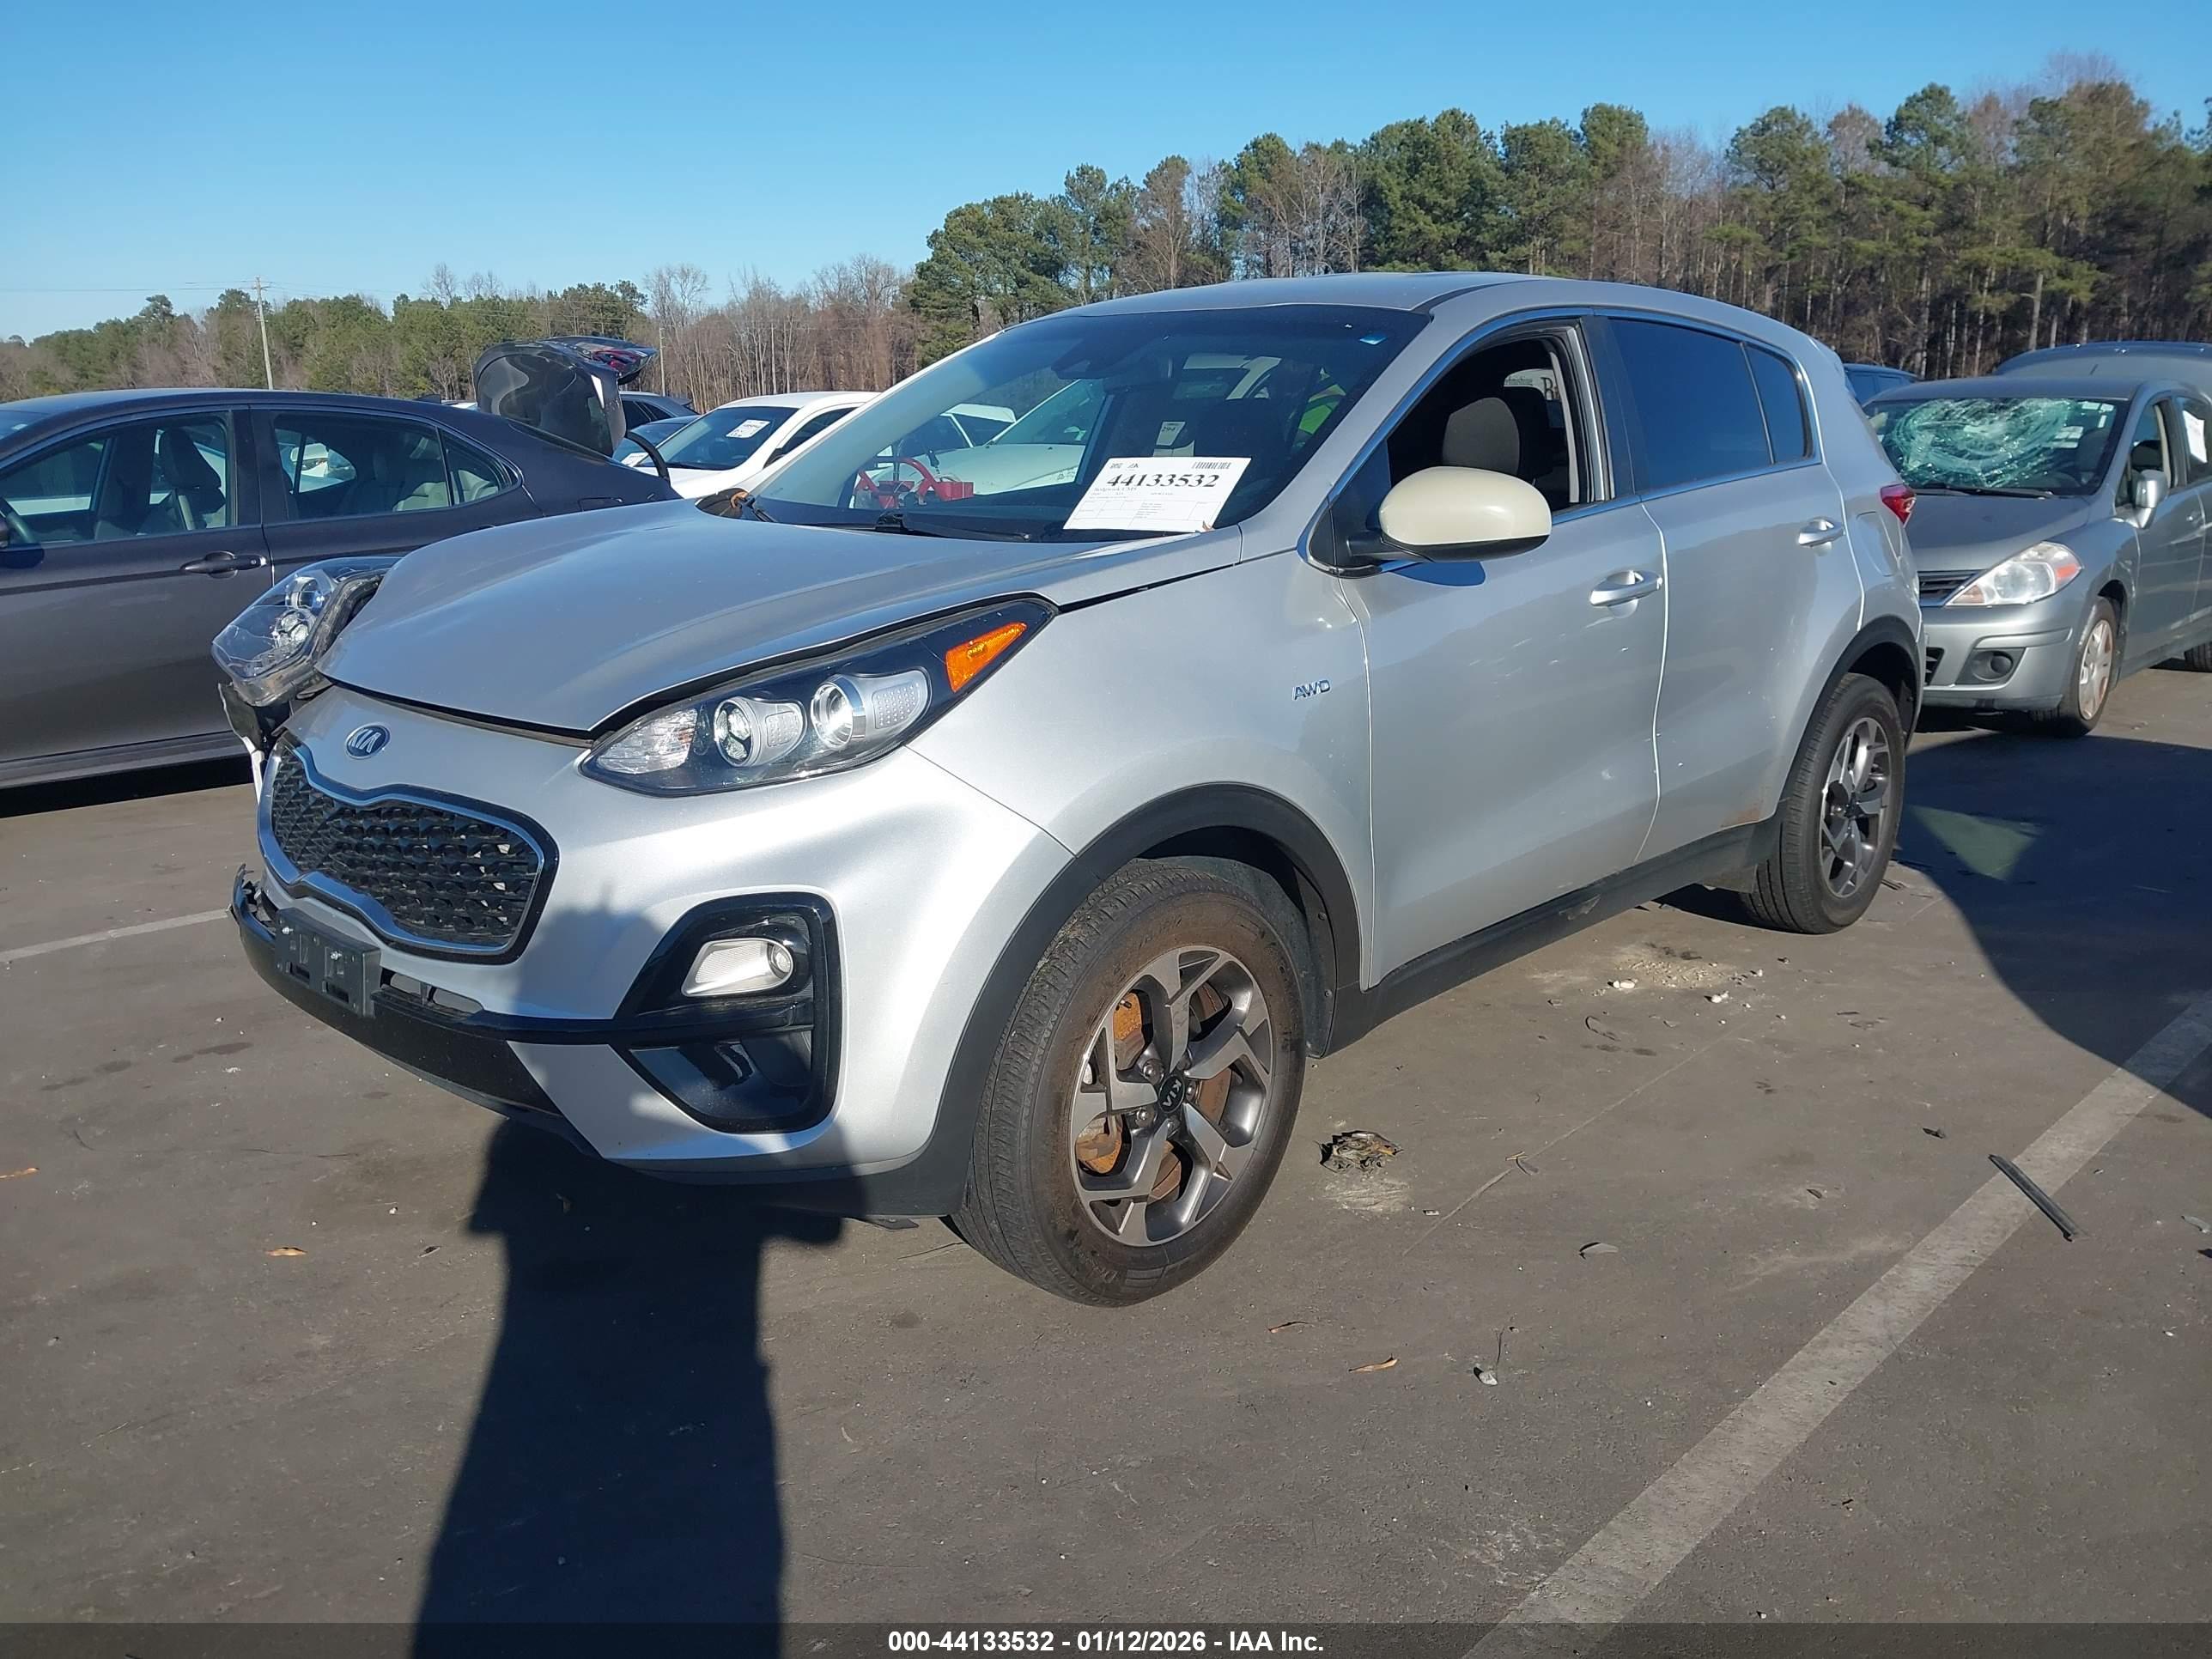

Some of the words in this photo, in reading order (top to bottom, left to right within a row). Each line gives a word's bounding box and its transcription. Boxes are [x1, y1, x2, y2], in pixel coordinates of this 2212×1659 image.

[1107, 473, 1220, 488] 44133532
[1292, 679, 1331, 701] AWD
[348, 728, 382, 754] KIA
[1162, 1079, 1182, 1107] KIA
